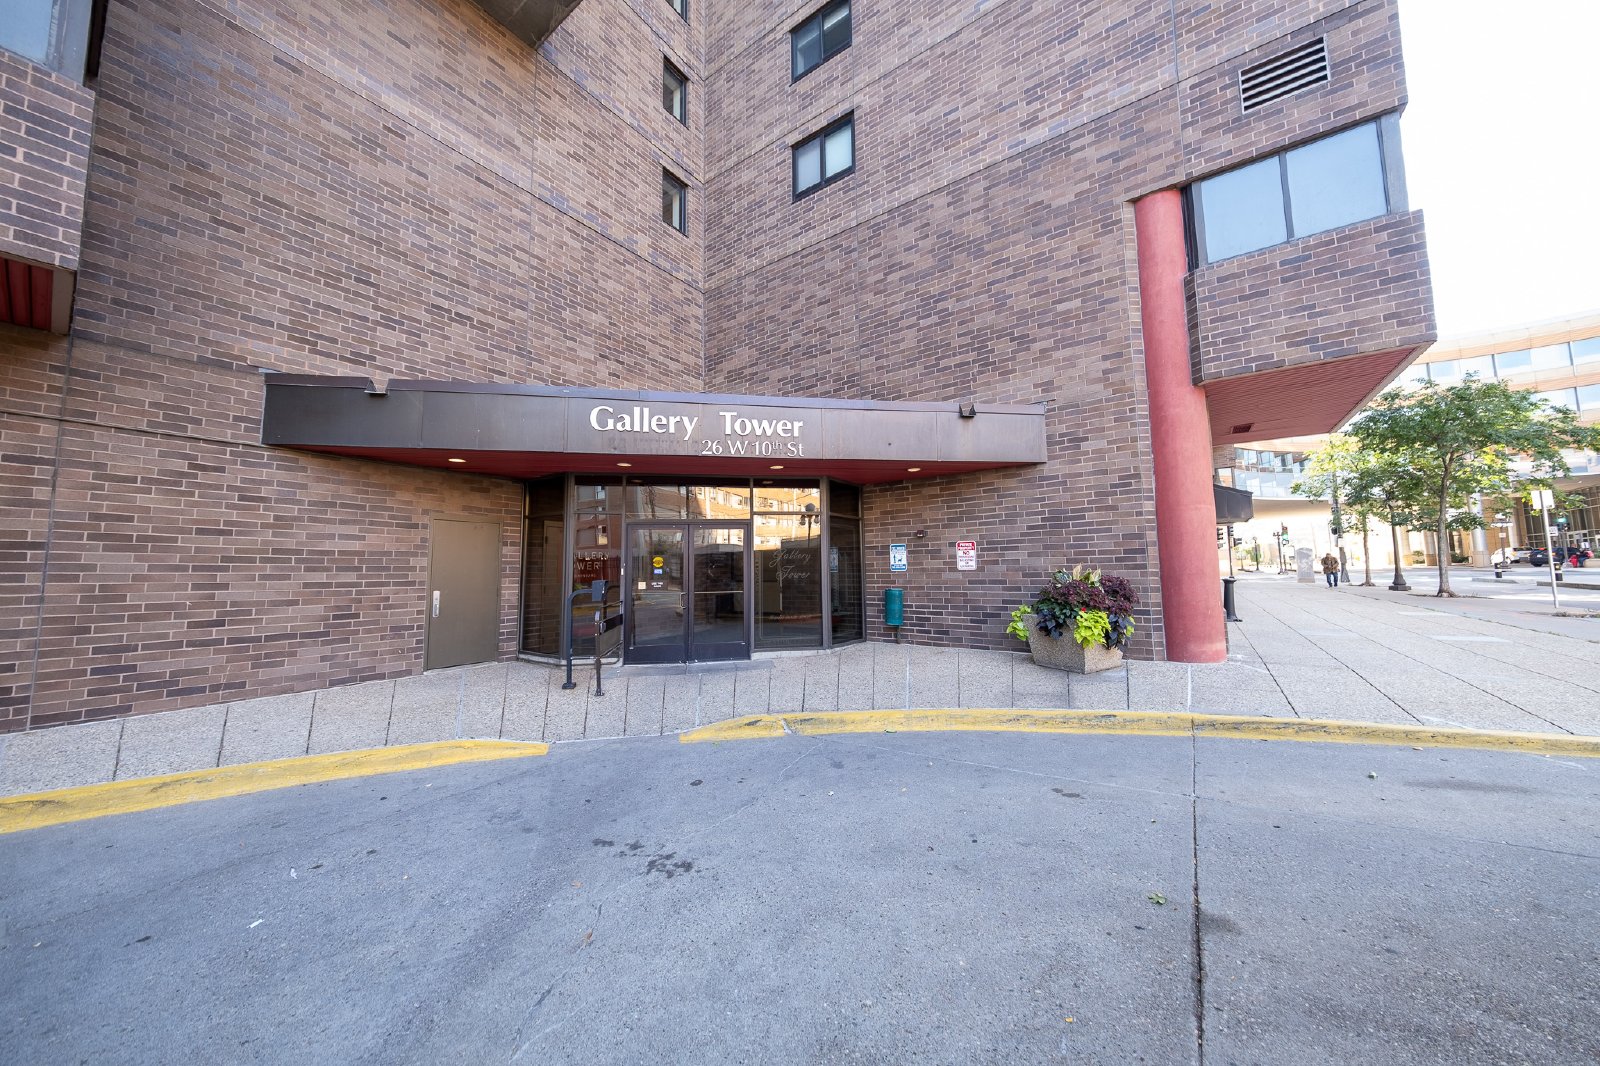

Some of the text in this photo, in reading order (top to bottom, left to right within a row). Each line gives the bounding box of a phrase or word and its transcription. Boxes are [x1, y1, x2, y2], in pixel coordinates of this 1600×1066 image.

[590, 406, 803, 440] Gallery Tower
[701, 440, 804, 457] 26 W 10th St
[574, 562, 600, 570] WER
[769, 548, 811, 567] Gallery
[776, 565, 810, 580] Tower
